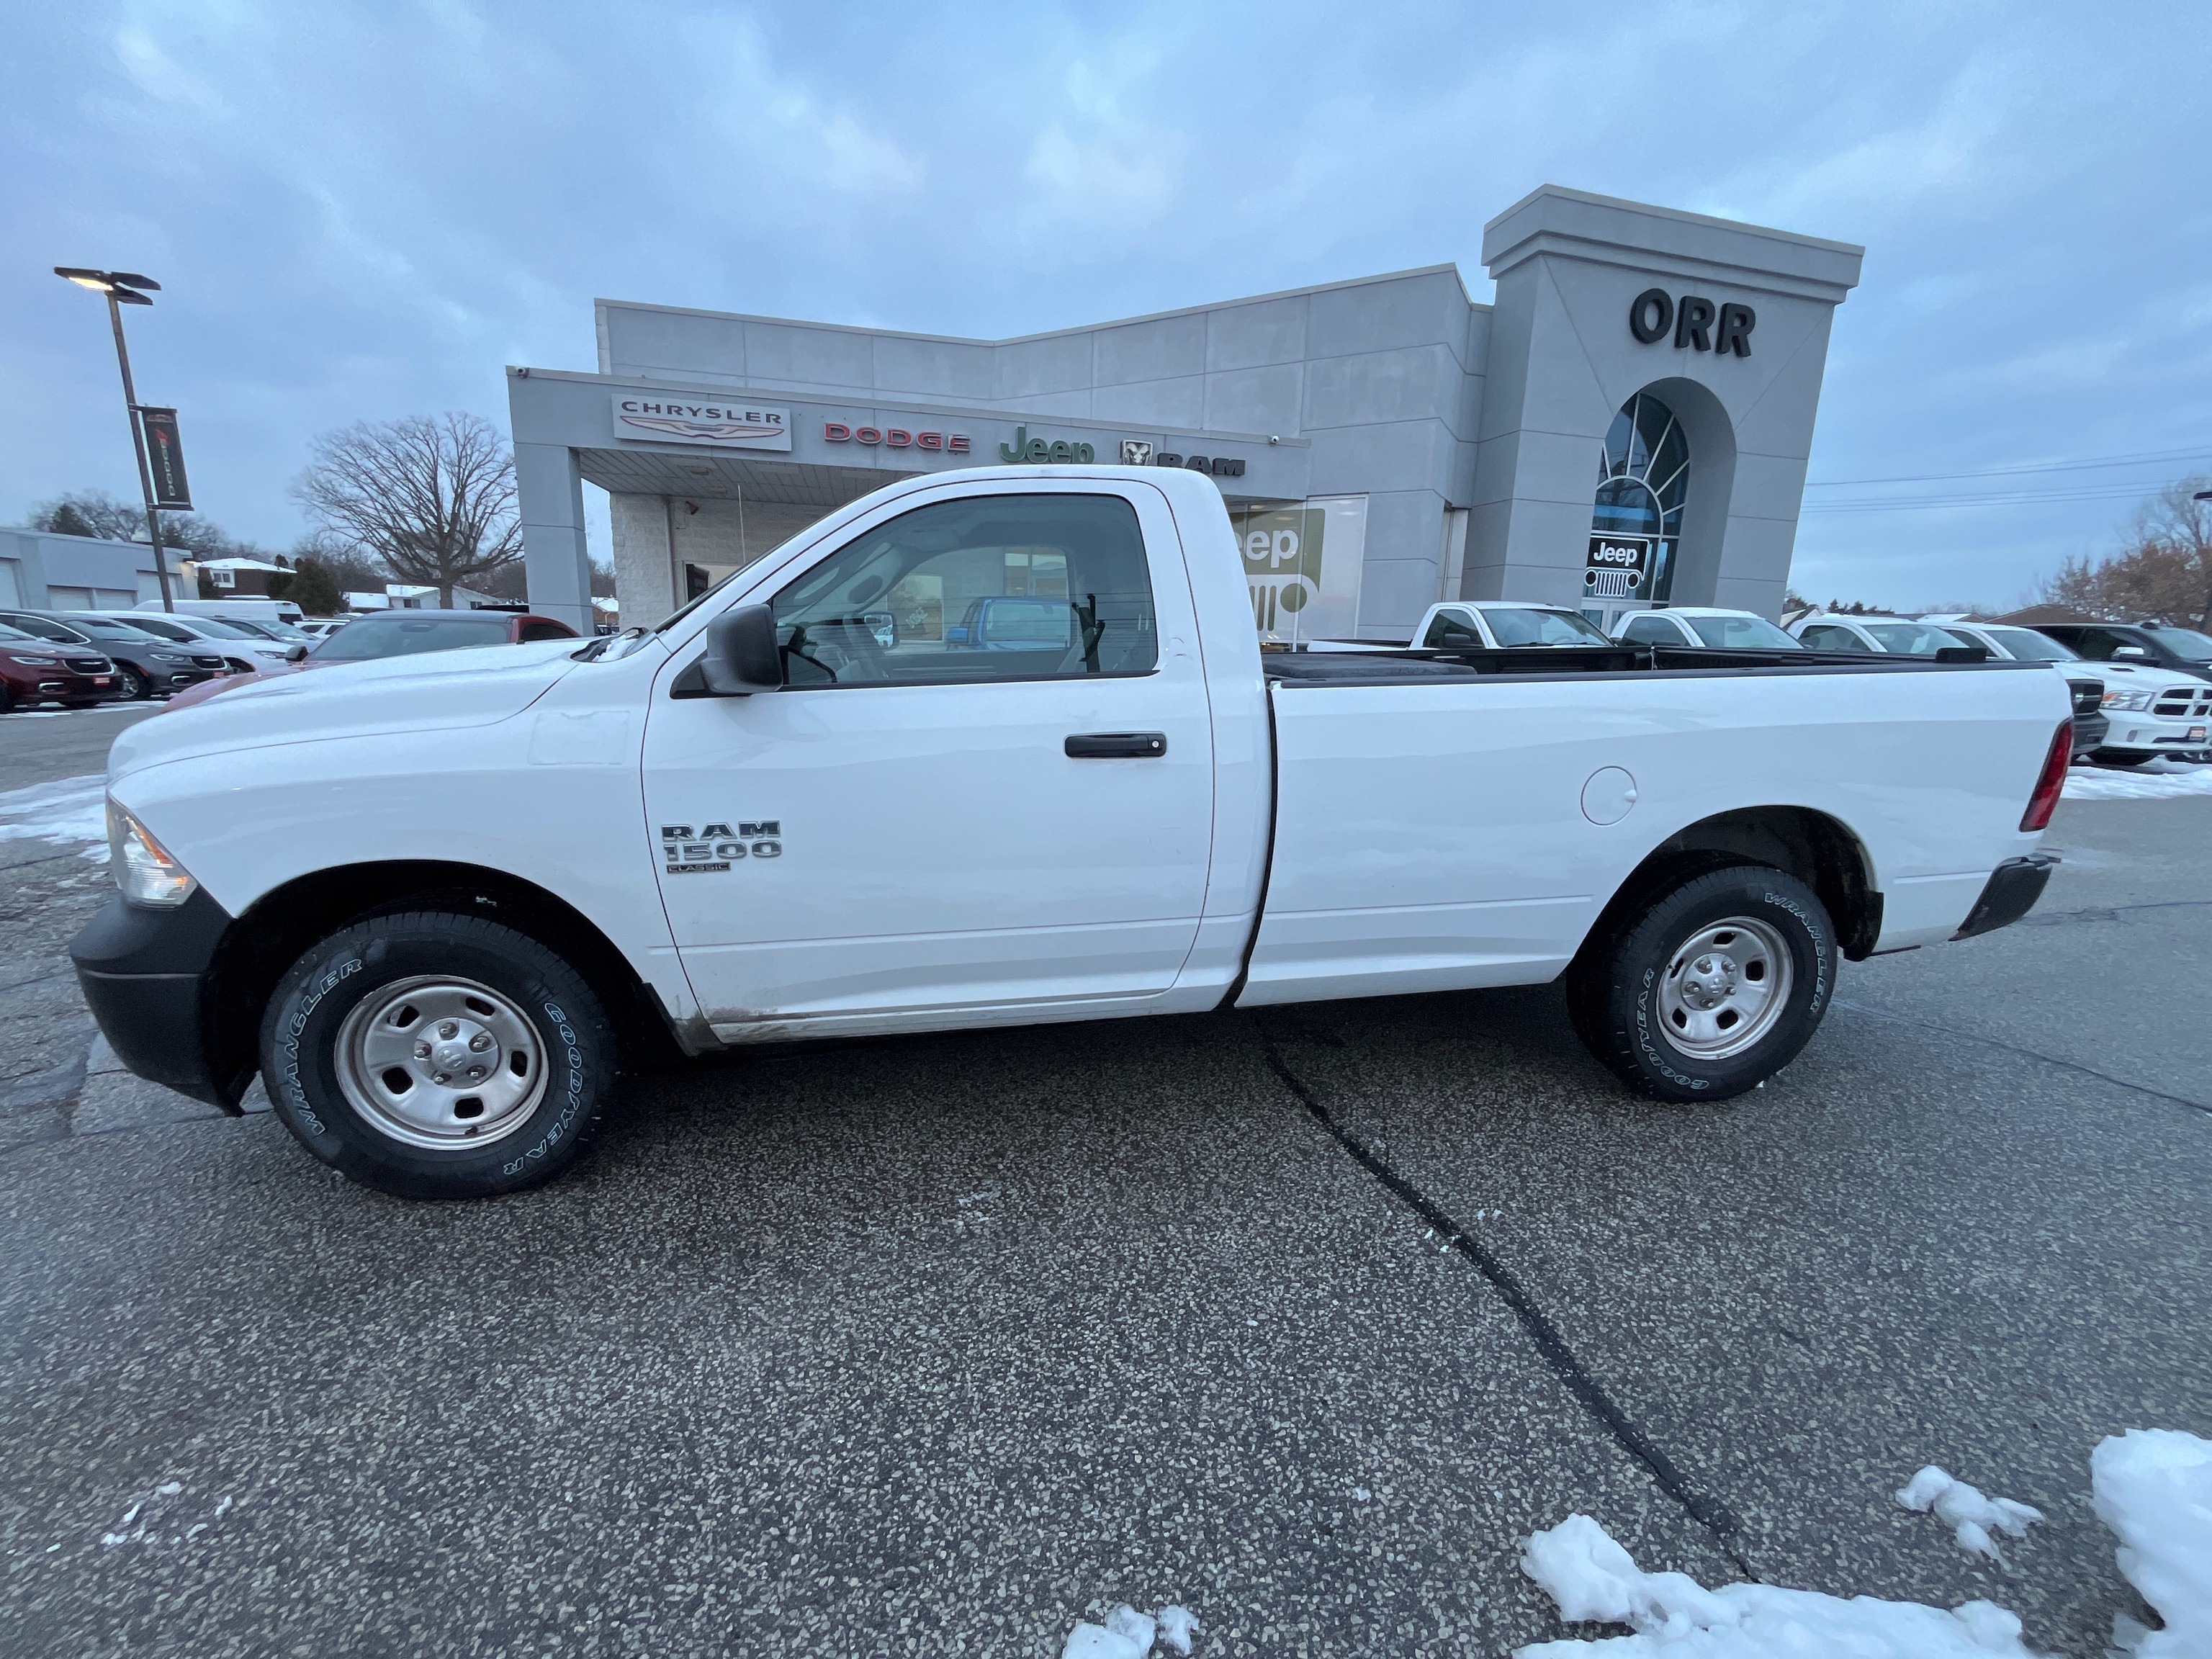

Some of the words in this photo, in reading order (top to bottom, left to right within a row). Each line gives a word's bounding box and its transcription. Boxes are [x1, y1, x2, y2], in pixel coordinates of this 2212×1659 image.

[1630, 288, 1755, 357] ORR
[621, 400, 781, 424] CHRYSLER
[824, 422, 971, 451] DODGE
[1157, 453, 1246, 476] RAM
[1593, 541, 1637, 567] Jeep
[661, 820, 781, 842] RAM
[663, 840, 782, 862] 1500
[667, 863, 730, 873] CLASSIC
[1764, 892, 1827, 1013] WRANGLER
[1637, 968, 1709, 1089] GOODYEAR
[283, 958, 362, 1136] WRANGLER
[504, 1002, 583, 1175] GOODYEAR
